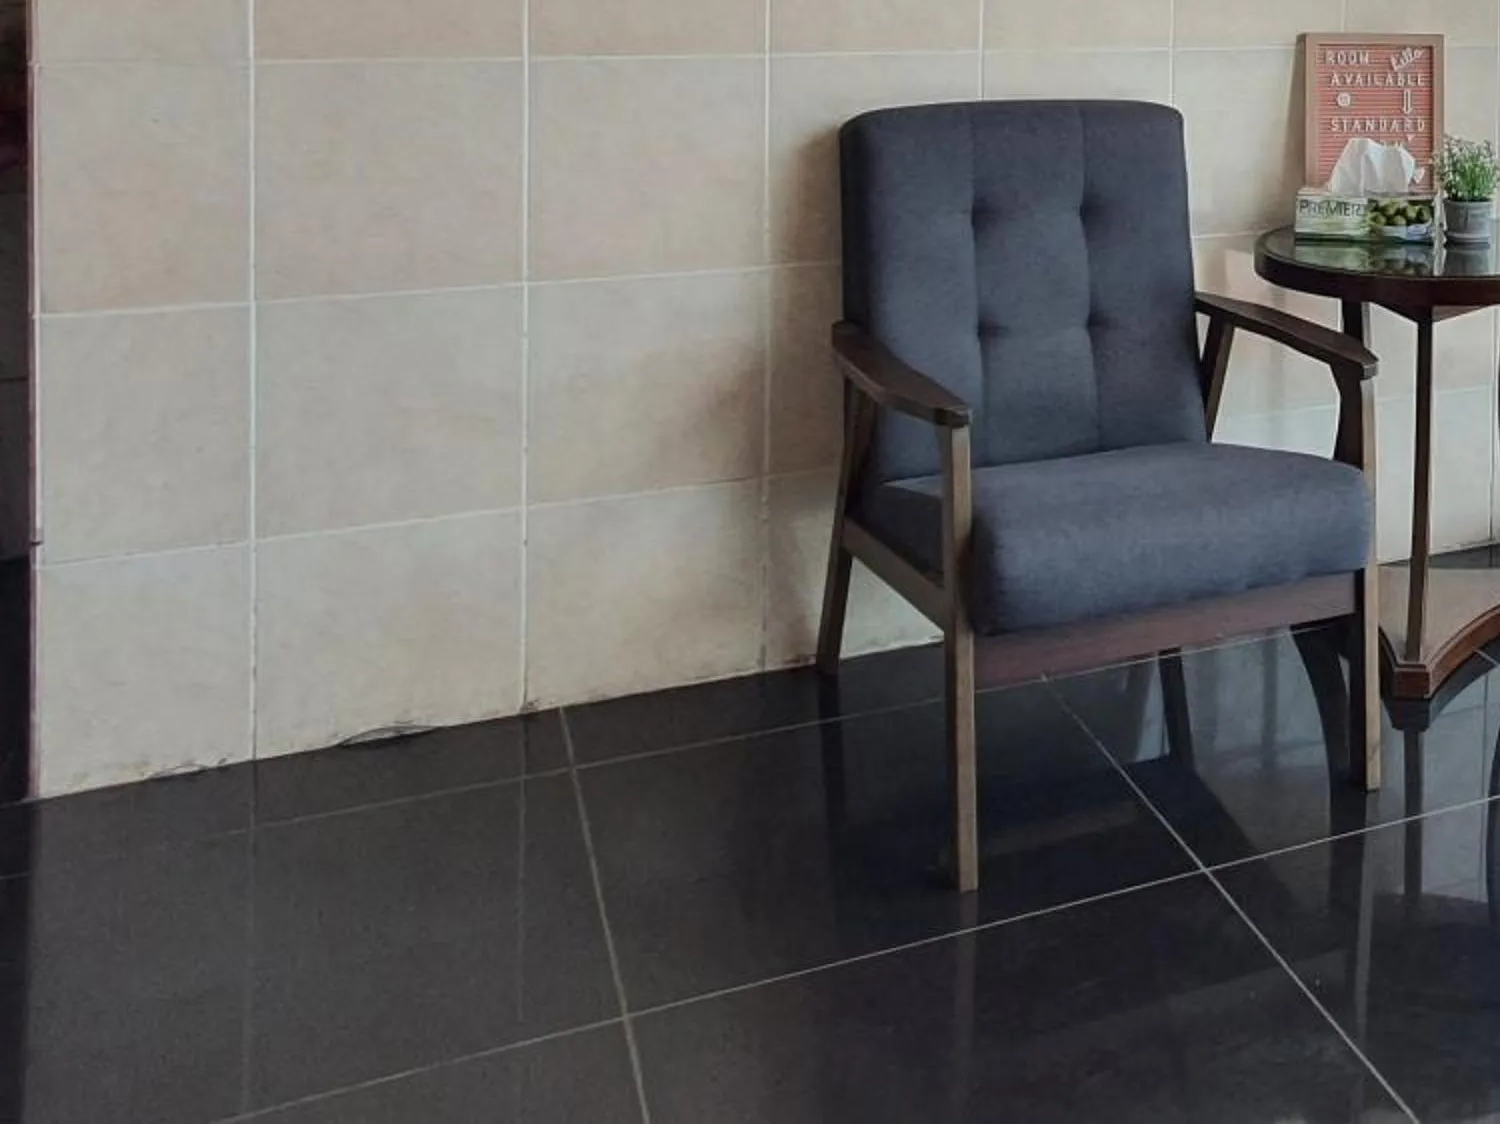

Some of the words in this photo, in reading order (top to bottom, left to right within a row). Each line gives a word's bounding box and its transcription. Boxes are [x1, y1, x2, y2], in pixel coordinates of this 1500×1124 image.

[1325, 50, 1369, 65] ROOM
[1331, 72, 1425, 86] AVAILABLE
[1331, 119, 1425, 133] STANDARD
